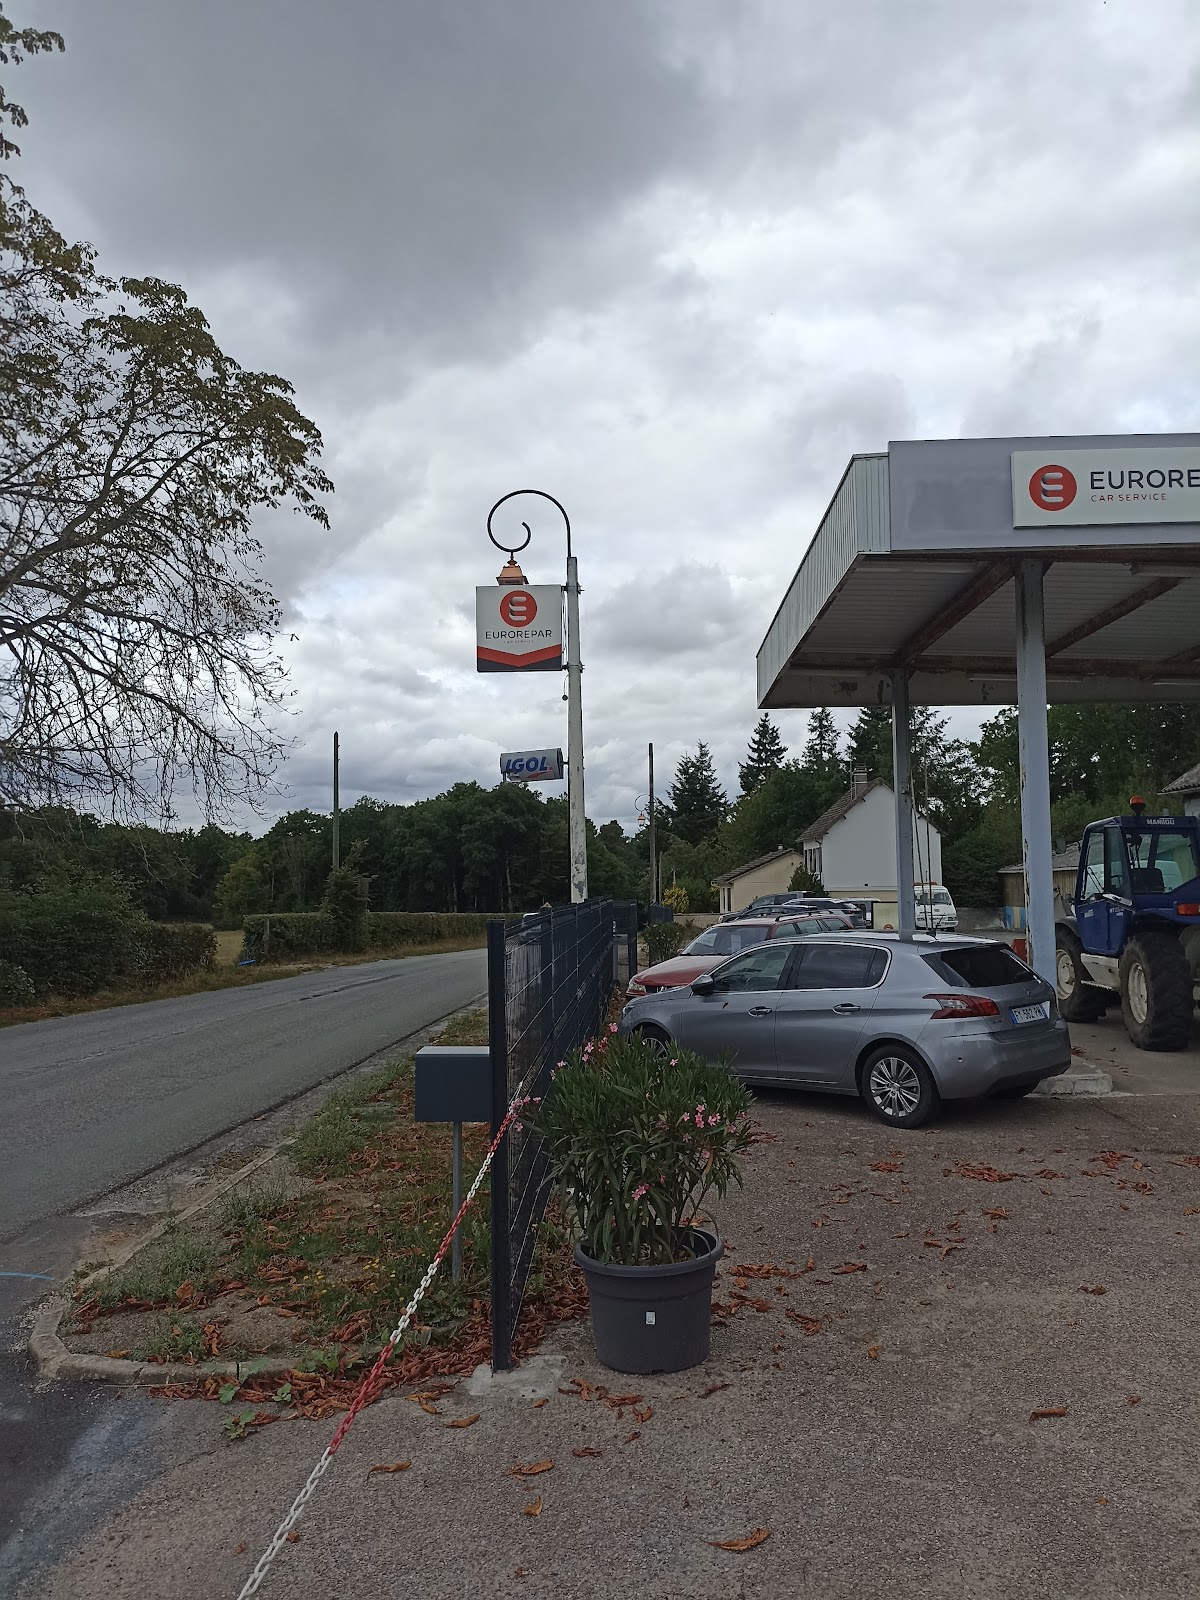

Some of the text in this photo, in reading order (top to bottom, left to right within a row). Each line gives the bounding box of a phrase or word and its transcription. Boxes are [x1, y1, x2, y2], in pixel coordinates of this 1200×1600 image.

[1090, 469, 1200, 490] EURORE
[1090, 493, 1167, 502] CAR SERVICE
[485, 629, 552, 639] EUROREPAR
[505, 756, 548, 773] IGOL
